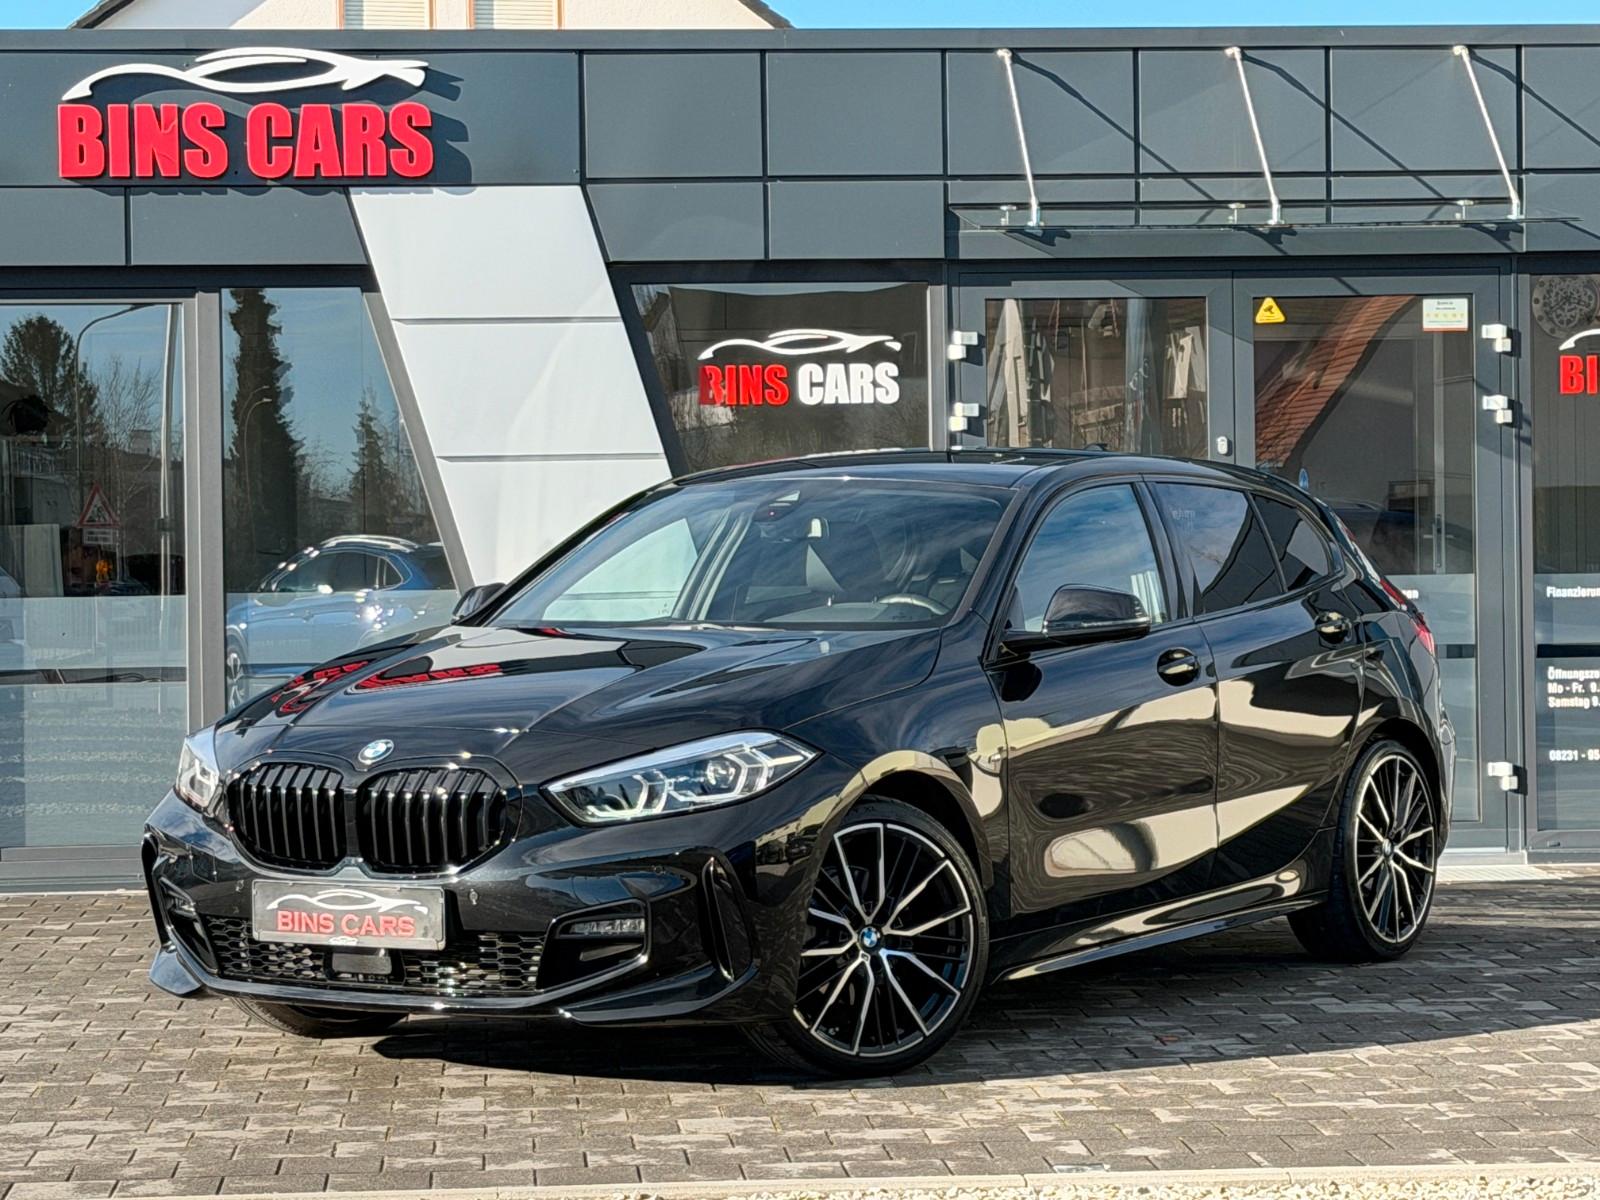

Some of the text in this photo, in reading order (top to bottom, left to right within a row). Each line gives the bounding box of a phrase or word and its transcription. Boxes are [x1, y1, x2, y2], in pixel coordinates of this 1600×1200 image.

[57, 102, 434, 179] BINS CARS
[698, 362, 900, 407] BINS CARS
[1548, 682, 1563, 694] Mo
[1572, 682, 1585, 694] Fr.
[1548, 696, 1590, 710] Samstag
[1549, 749, 1578, 761] 08231
[276, 910, 416, 938] BINS CARS
